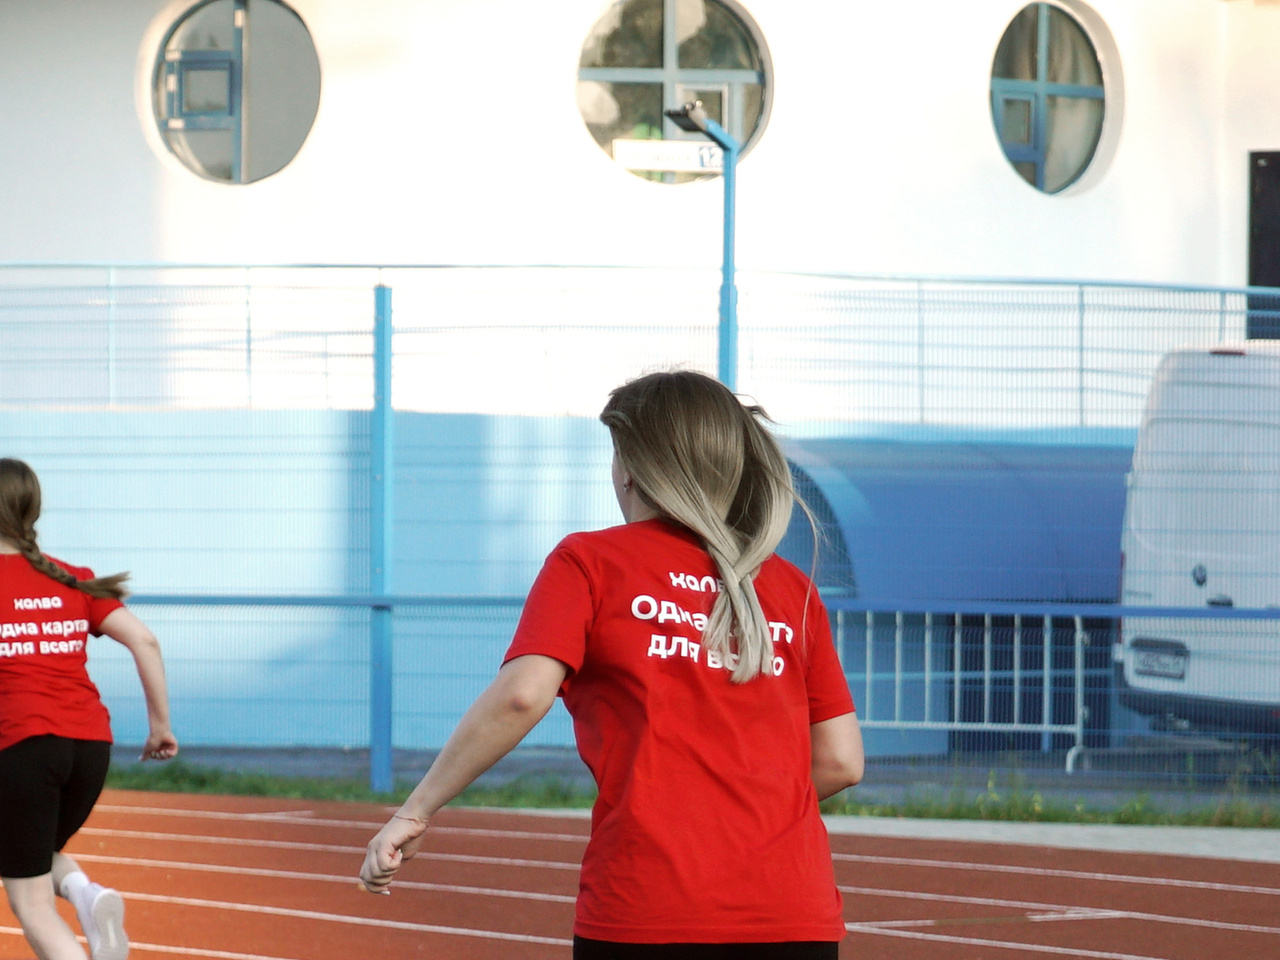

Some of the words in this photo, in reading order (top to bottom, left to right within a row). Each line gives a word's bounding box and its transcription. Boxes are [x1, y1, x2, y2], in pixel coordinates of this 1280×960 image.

[669, 572, 725, 592] хал
[13, 596, 62, 610] халва
[631, 595, 708, 631] Одна
[41, 619, 89, 637] карта
[39, 640, 83, 654] всего
[647, 634, 701, 663] для
